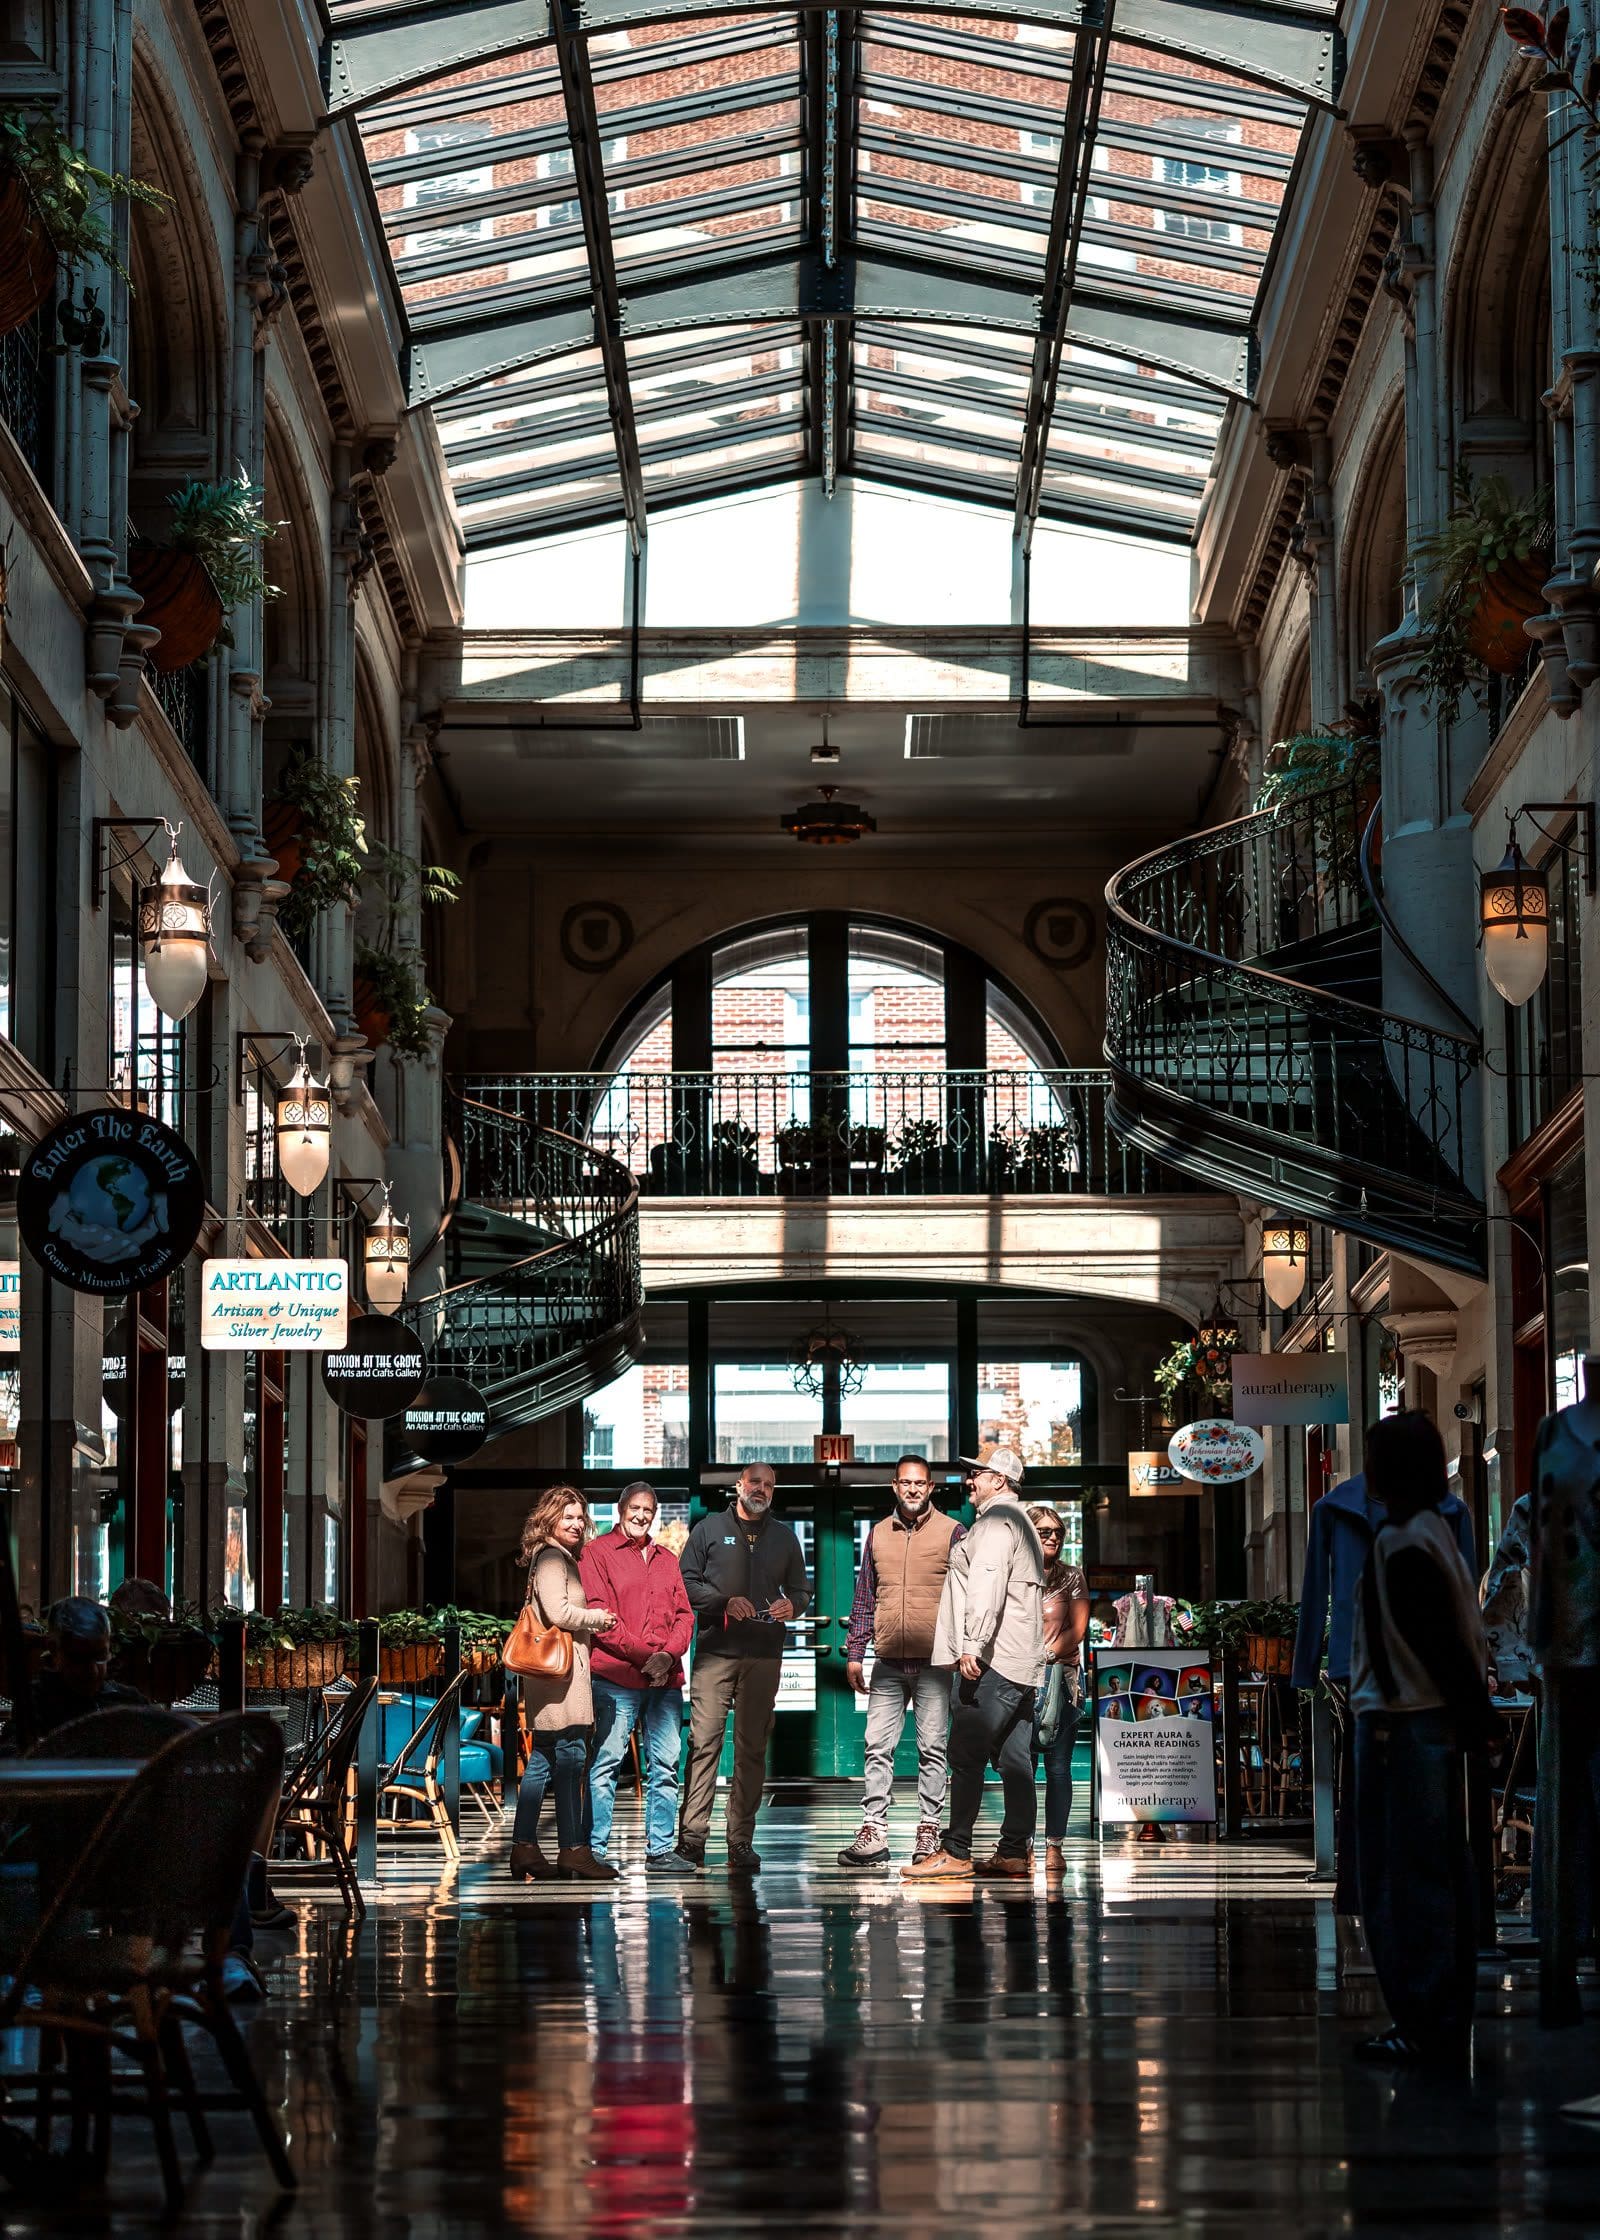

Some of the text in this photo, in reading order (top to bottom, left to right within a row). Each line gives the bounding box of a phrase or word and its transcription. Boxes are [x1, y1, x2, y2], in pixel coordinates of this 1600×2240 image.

[32, 1115, 190, 1184] Enter The Earth
[43, 1243, 173, 1288] Gems Minerals Fossils
[209, 1272, 343, 1291] ARTLANTIC
[211, 1302, 340, 1322] Artisan & Unique
[228, 1322, 323, 1342] Silver Jewelry
[327, 1355, 422, 1369] MISSION AT THE GROVE
[327, 1368, 422, 1379] An Arts and Crafts Gallery
[1241, 1379, 1337, 1398] auratherapy
[405, 1410, 486, 1424] MISSION AT THE GROVE
[405, 1422, 486, 1432] An Arts and Crafts Gallery
[820, 1437, 850, 1460] EXIT
[1188, 1446, 1245, 1458] Bohemian Baby
[1121, 1731, 1193, 1739] EXPERT AURA &
[1113, 1740, 1201, 1748] CHAKRA READINGS
[1118, 1792, 1198, 1809] auratherapy
